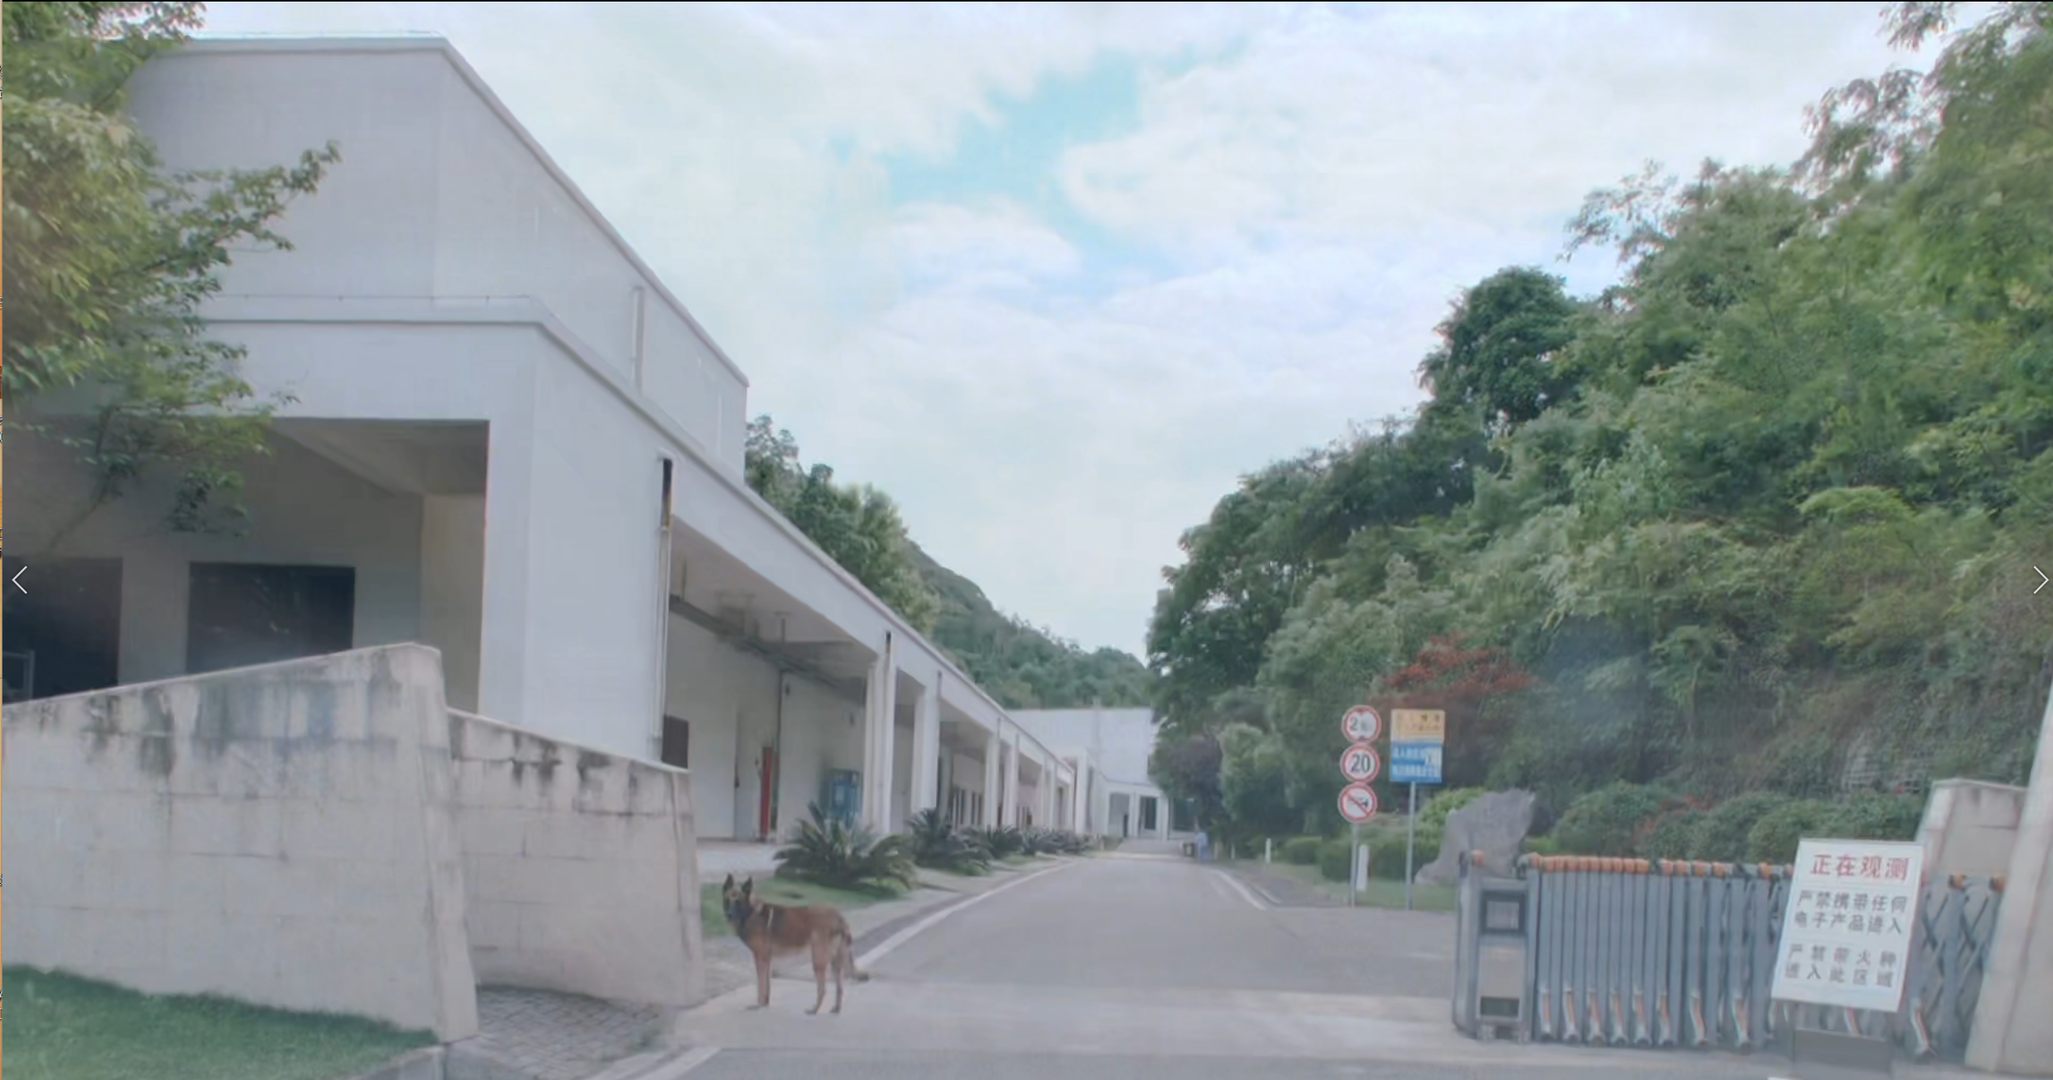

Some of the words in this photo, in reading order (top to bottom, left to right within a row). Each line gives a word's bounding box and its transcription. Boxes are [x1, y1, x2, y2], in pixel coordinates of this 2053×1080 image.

[1350, 754, 1371, 773] 20
[1810, 854, 1910, 881] 正在观测
[1797, 890, 1907, 914] 严禁携带任何
[1794, 912, 1903, 935] 电子产品进入
[1785, 962, 1895, 988] 进入此区域
